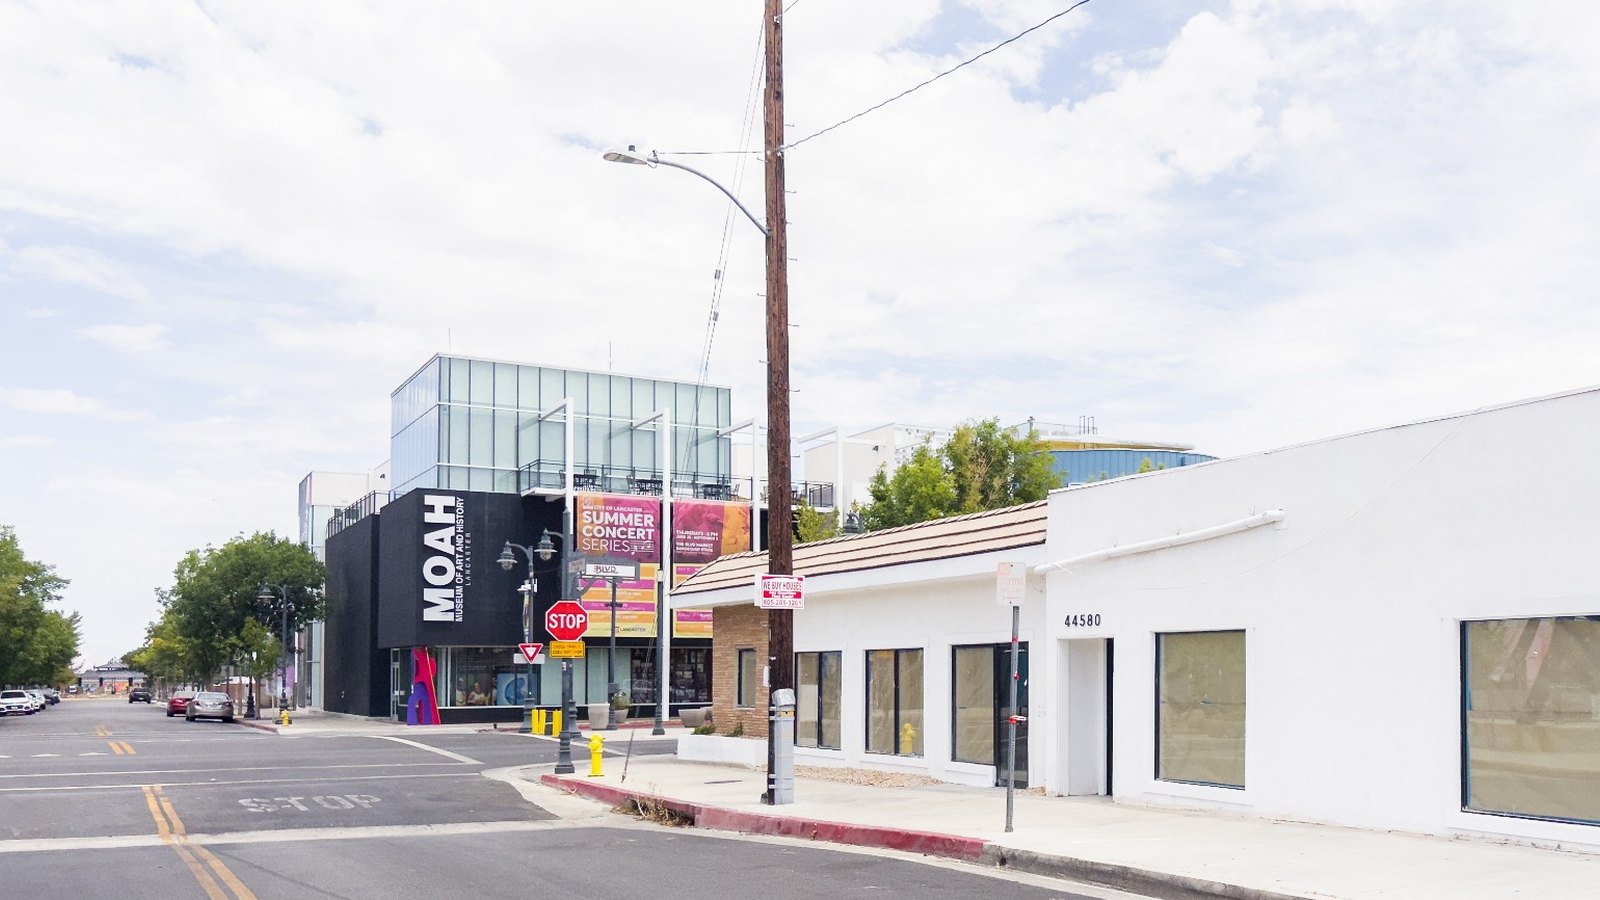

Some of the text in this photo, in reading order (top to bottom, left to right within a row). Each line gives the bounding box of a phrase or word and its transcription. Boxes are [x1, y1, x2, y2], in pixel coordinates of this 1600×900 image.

[582, 510, 654, 527] SUMMER
[582, 525, 655, 540] CONCERT
[582, 538, 631, 552] SERIES
[423, 495, 455, 621] MOAH
[455, 497, 464, 622] MUSEUM OF ART AND HISTORY
[772, 581, 782, 590] BUY
[549, 613, 586, 629] STOP
[1064, 613, 1101, 628] 44580
[239, 795, 382, 812] STOP
